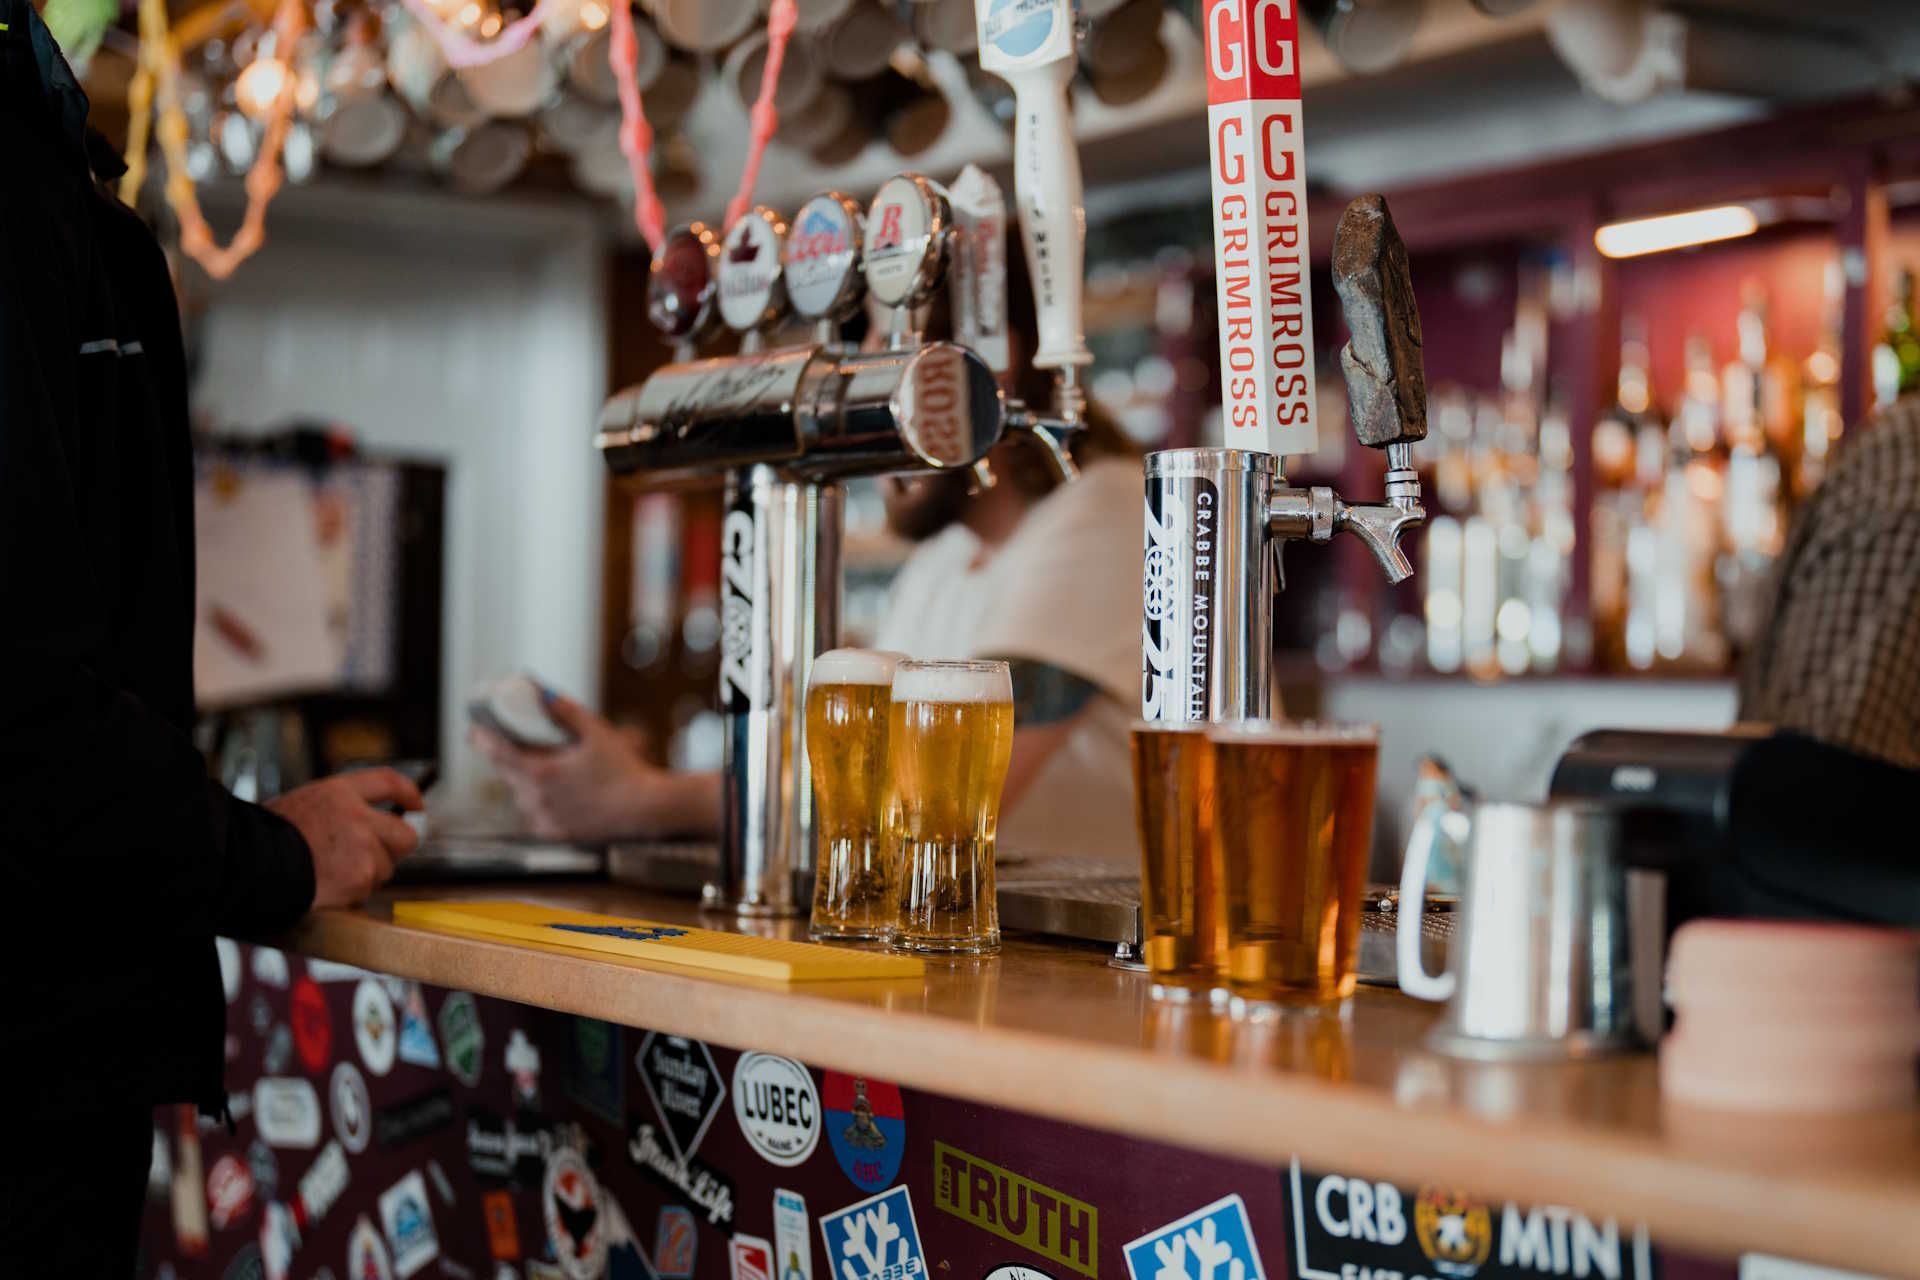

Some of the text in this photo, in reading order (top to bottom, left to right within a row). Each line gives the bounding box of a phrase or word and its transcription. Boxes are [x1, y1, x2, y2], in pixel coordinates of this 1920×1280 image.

[1209, 0, 1243, 81] G
[1254, 0, 1295, 77] G
[1217, 116, 1246, 186] G
[1261, 113, 1297, 182] G
[1221, 193, 1258, 430] GRIMROSS
[1265, 189, 1309, 427] GRIMROSS
[1194, 492, 1213, 581] CRABBE
[741, 1080, 813, 1130] LUBEC
[942, 1151, 1090, 1268] TRUTH
[1315, 1174, 1622, 1280] CRB MTN
